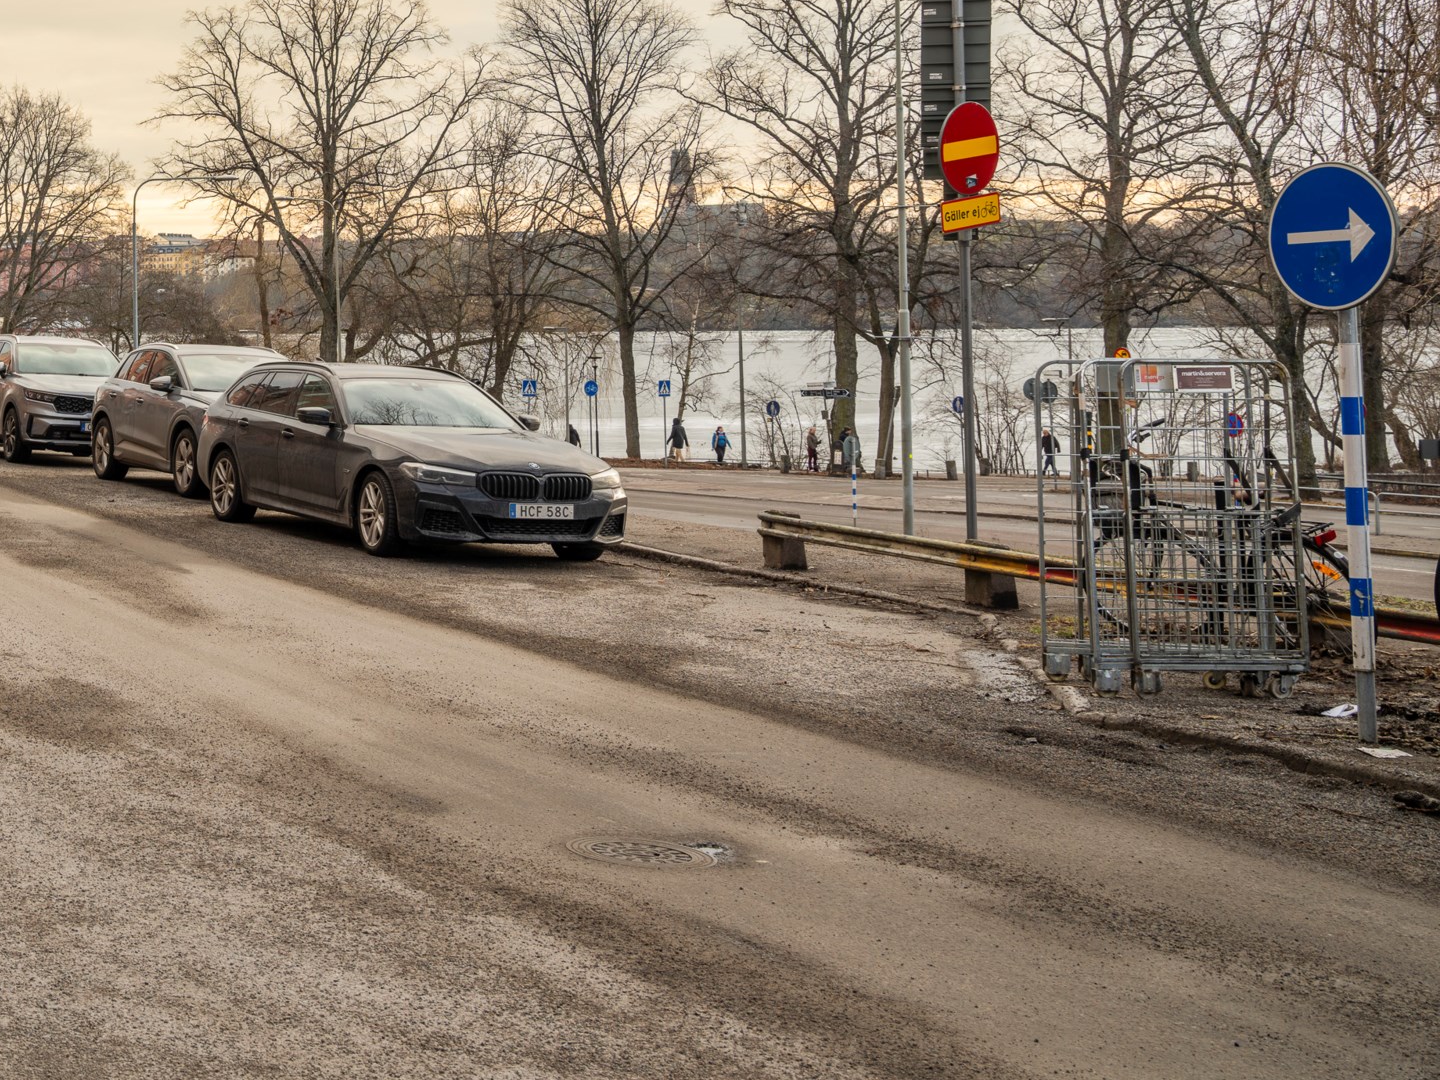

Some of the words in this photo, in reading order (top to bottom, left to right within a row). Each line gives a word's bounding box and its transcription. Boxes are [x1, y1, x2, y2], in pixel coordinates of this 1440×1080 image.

[945, 210, 970, 222] Gäller
[972, 206, 980, 218] ej
[520, 505, 543, 517] HCF
[546, 506, 569, 518] 58C
